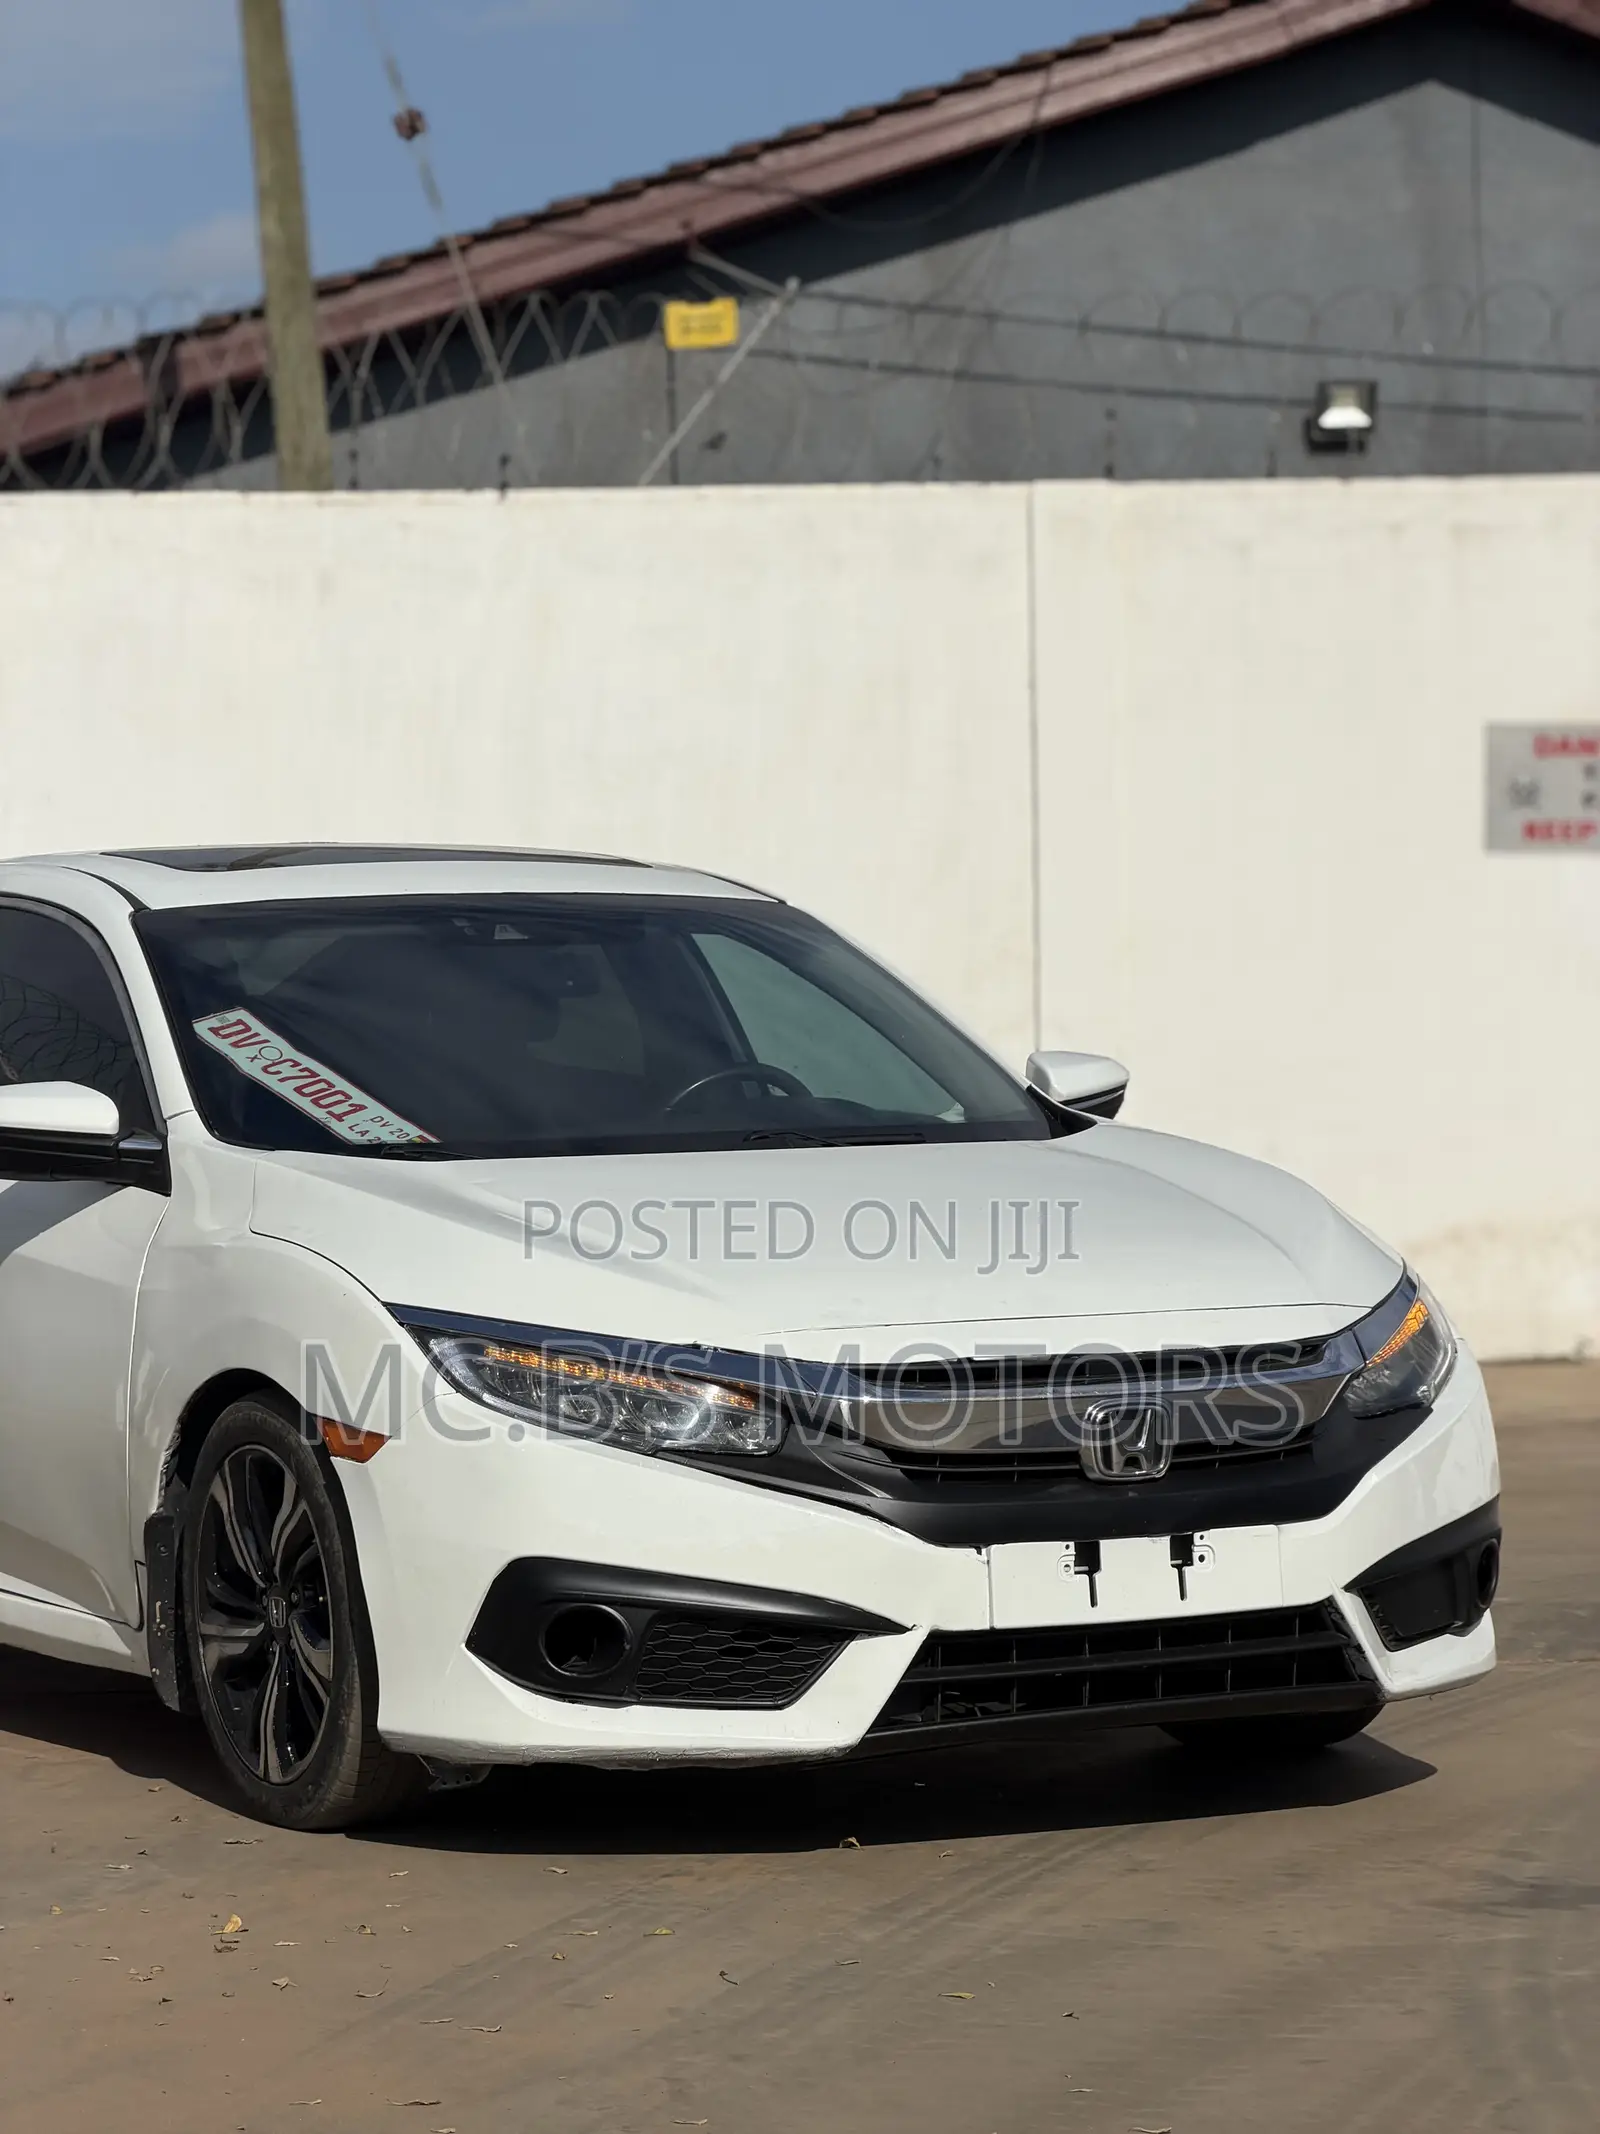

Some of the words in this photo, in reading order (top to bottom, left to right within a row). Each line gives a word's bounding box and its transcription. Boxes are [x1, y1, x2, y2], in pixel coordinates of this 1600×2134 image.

[207, 1018, 271, 1049] DV
[260, 1058, 369, 1123] C7001
[347, 1123, 370, 1138] LA
[369, 1115, 394, 1128] DV
[388, 1127, 411, 1139] 20
